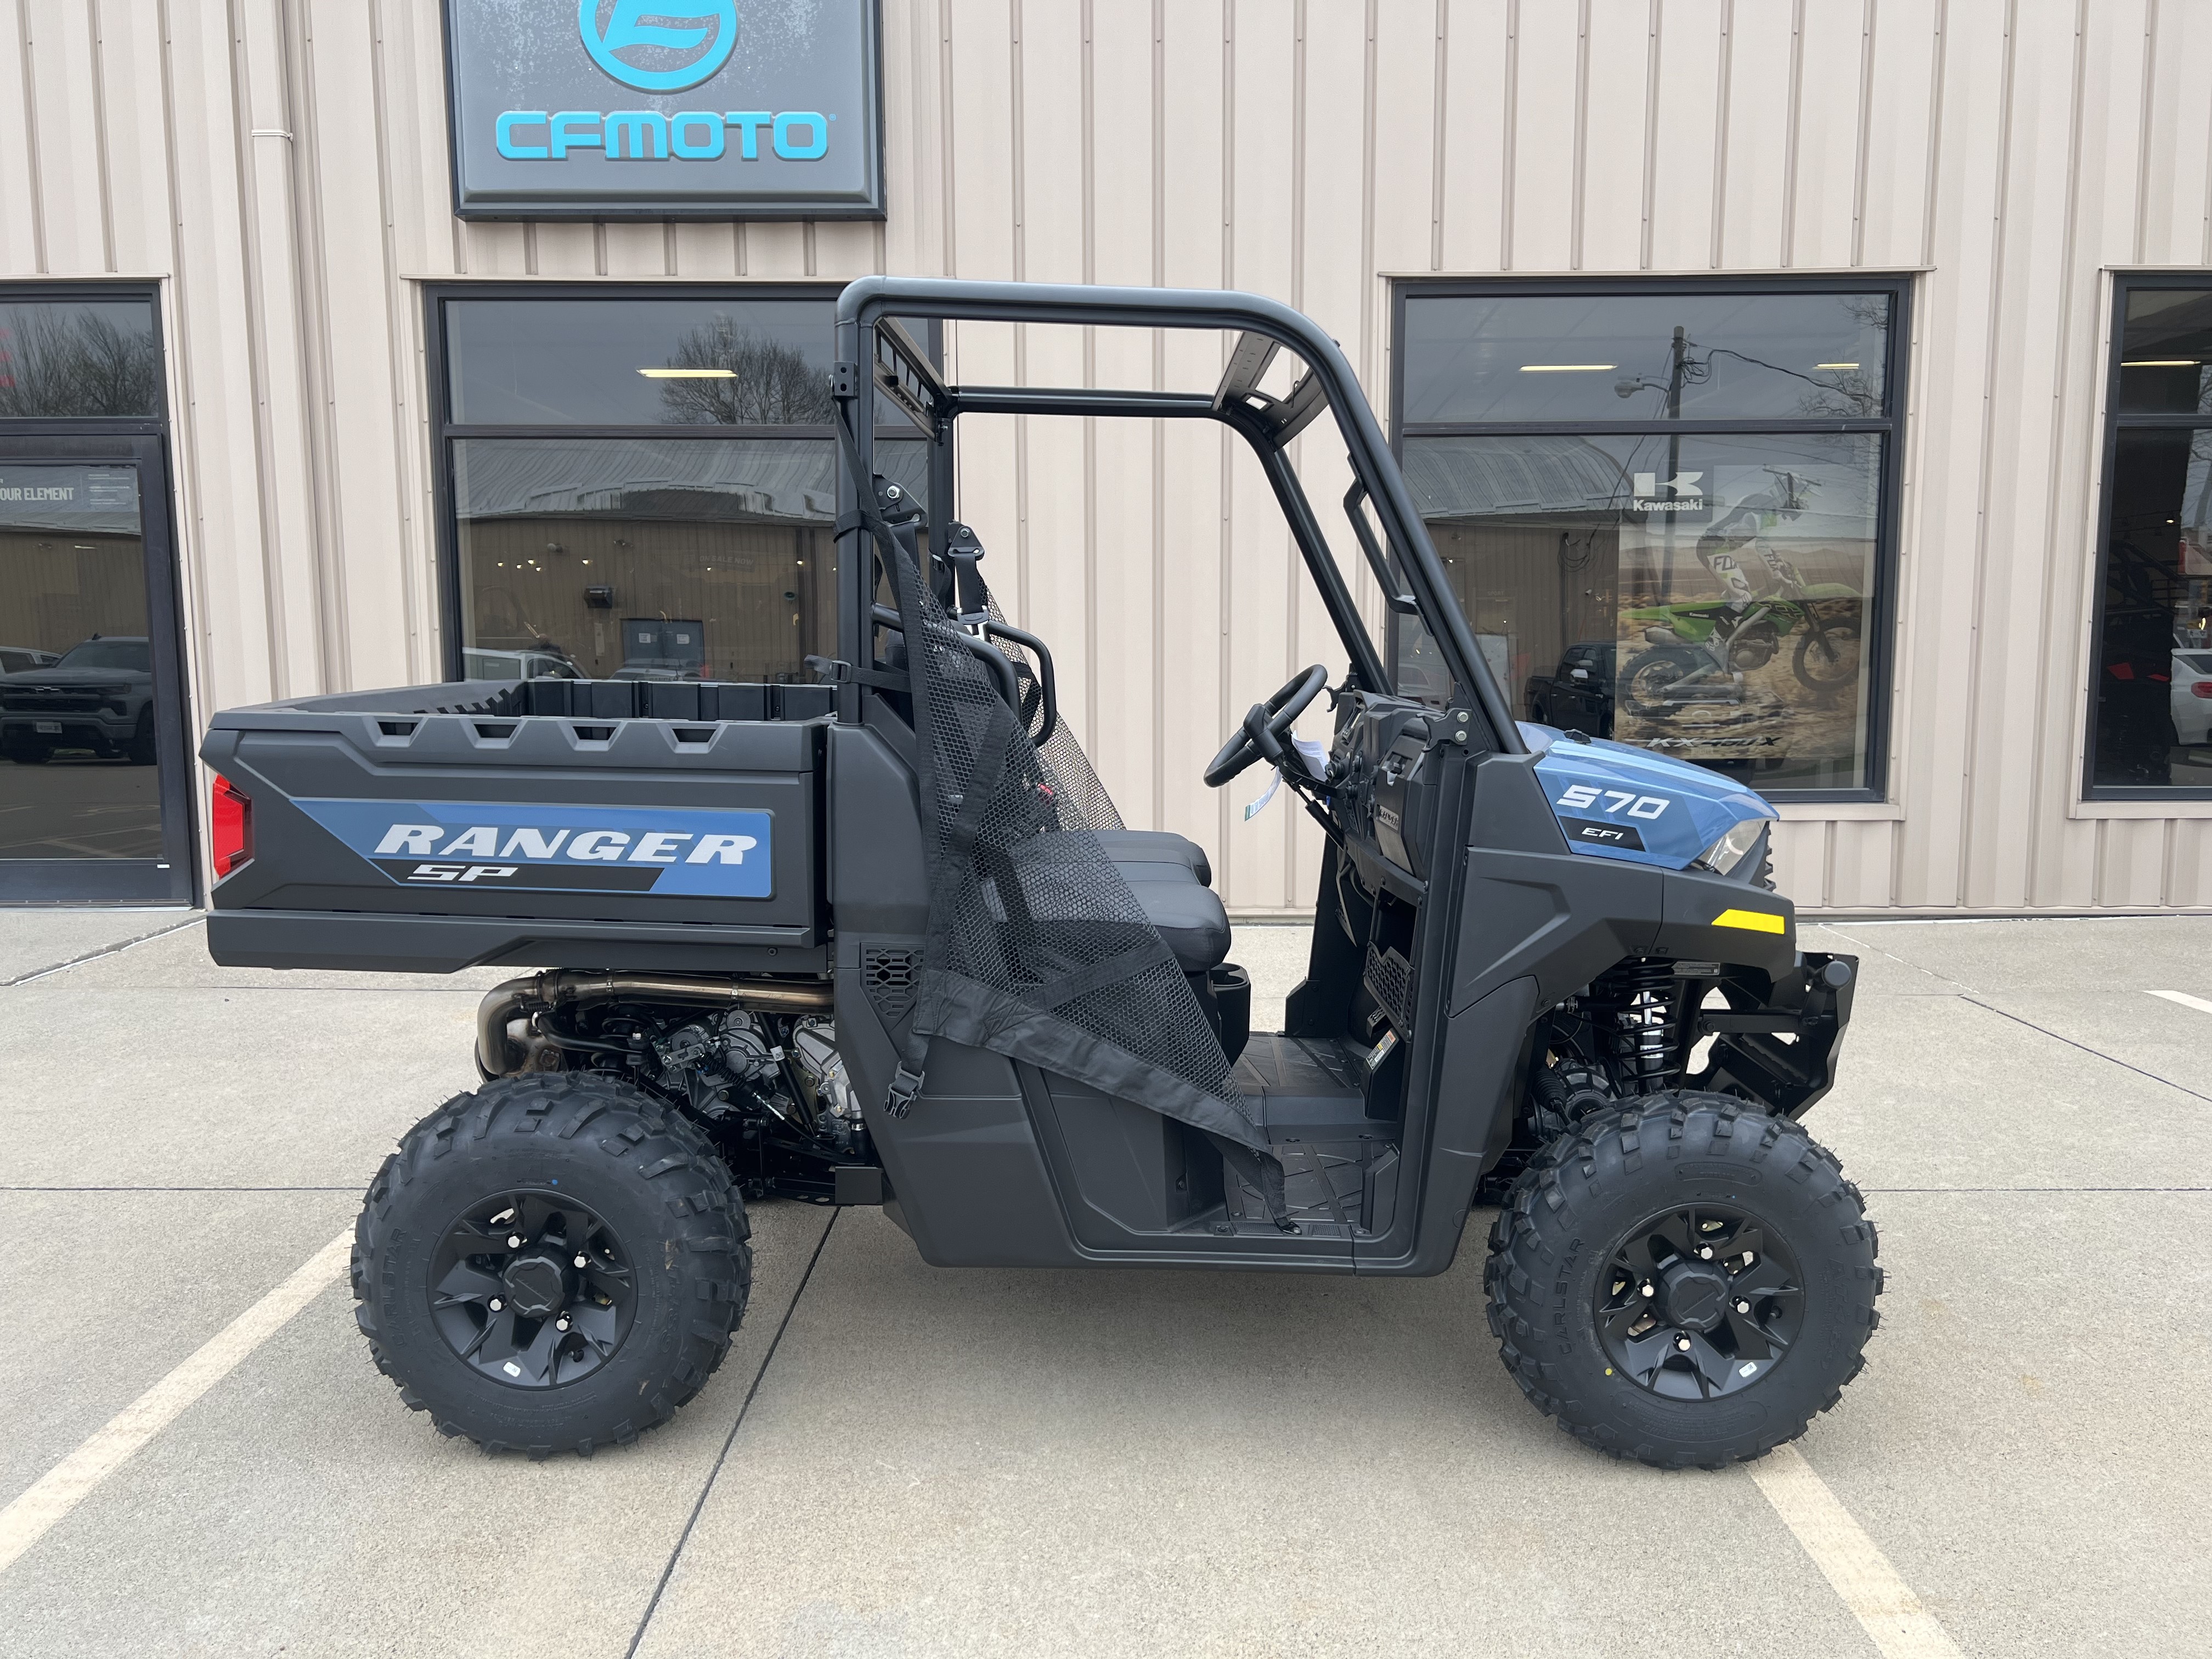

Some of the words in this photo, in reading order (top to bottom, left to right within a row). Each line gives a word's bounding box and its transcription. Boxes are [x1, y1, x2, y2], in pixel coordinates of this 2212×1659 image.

[496, 110, 829, 160] CFMOTO
[0, 487, 22, 501] OUR
[24, 487, 75, 501] ELEMENT
[1633, 498, 1703, 511] Kawasaki
[735, 557, 754, 566] NOW
[1556, 784, 1671, 820] 570
[373, 823, 758, 865] RANGER
[1581, 827, 1624, 840] EFI
[407, 864, 518, 882] SP
[382, 1227, 407, 1347] CARLSTAR
[1553, 1236, 1586, 1356] CARLSTAR
